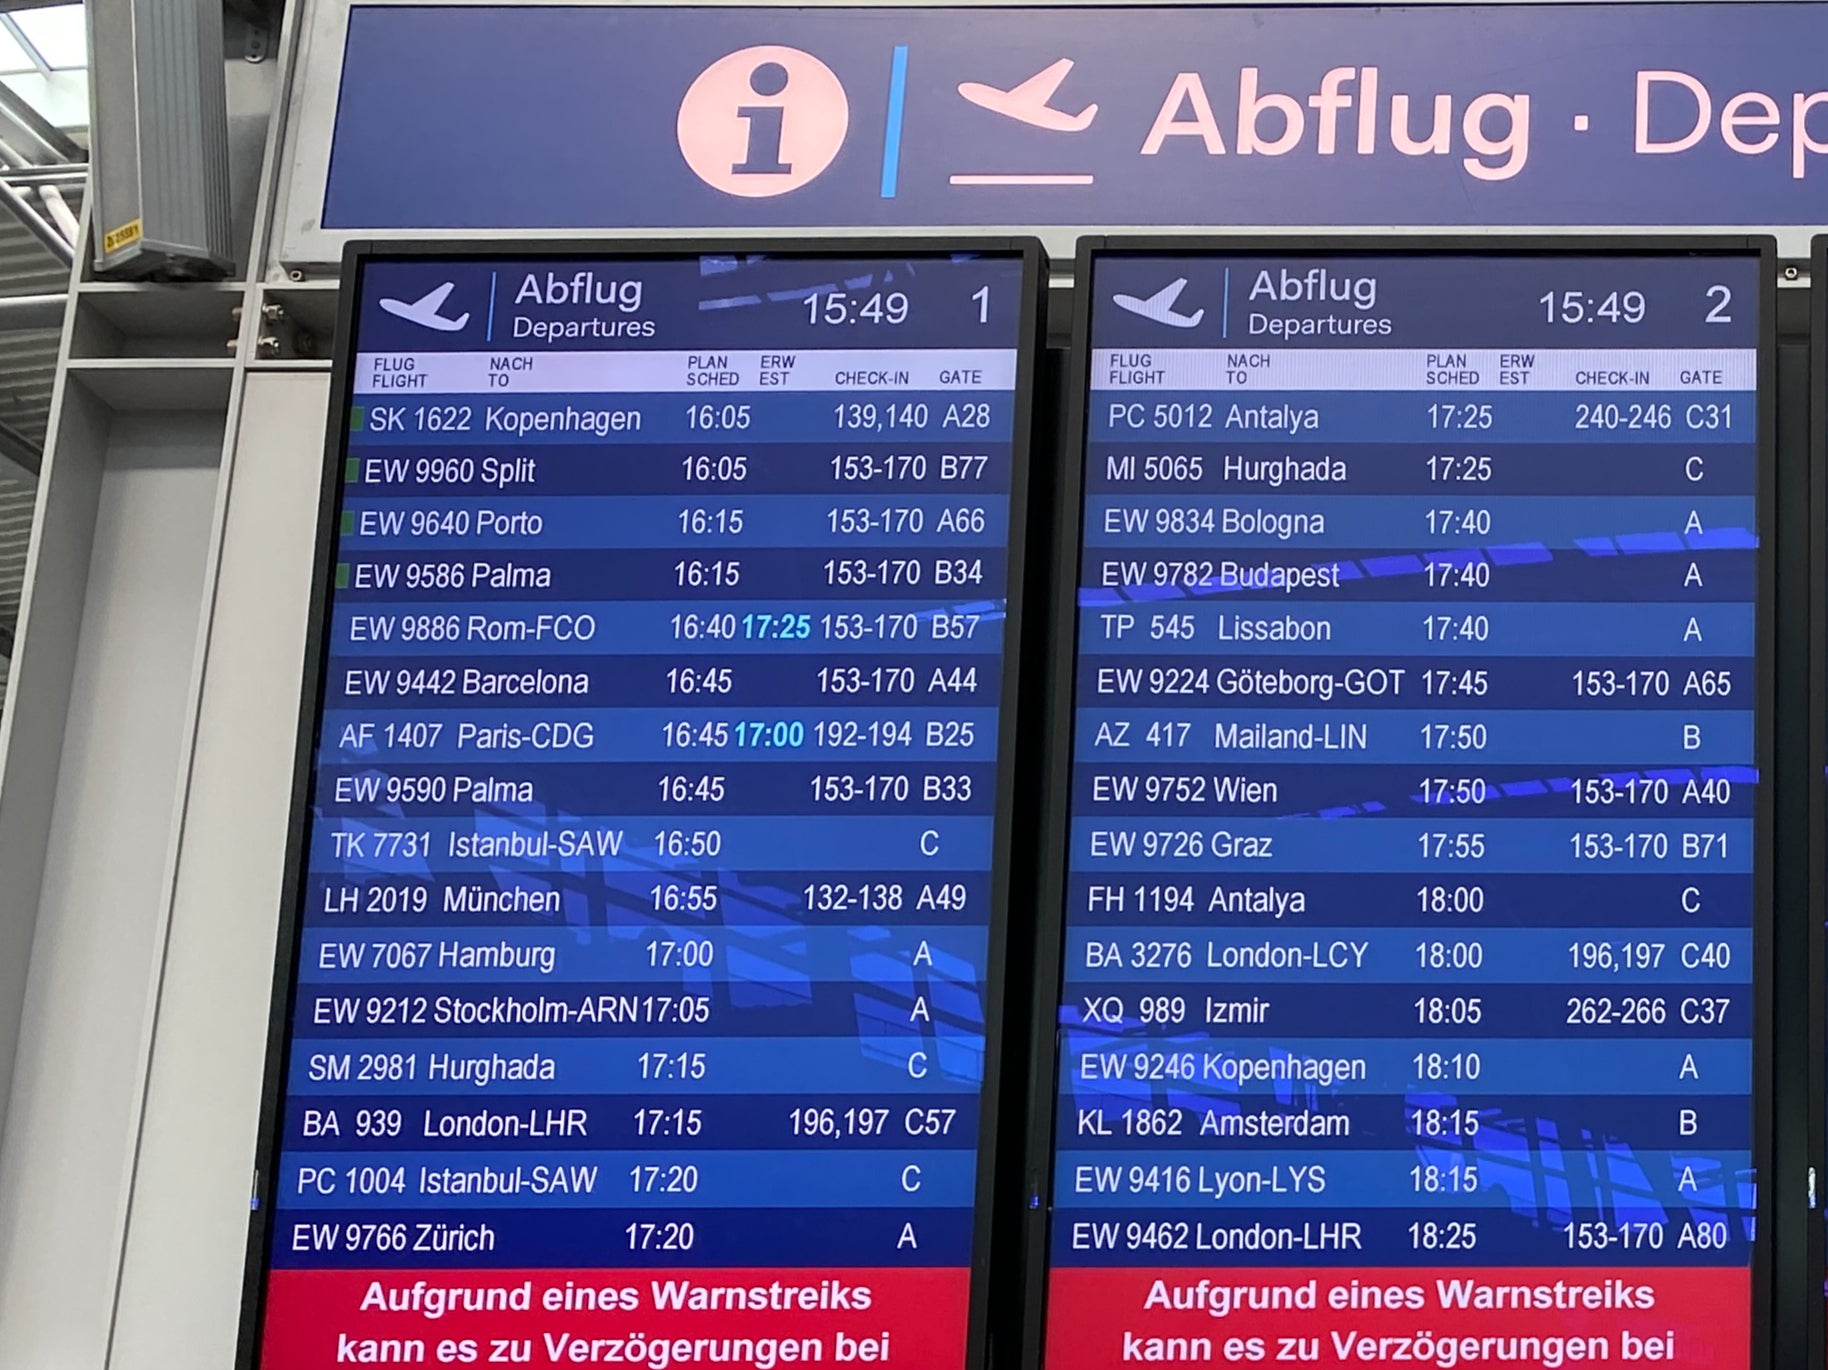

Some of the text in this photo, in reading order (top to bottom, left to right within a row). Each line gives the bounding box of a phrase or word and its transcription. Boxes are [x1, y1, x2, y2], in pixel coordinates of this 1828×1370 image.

[1141, 67, 1529, 180] Abflug
[515, 272, 988, 324] Abflug 15:49 1
[1249, 268, 1731, 323] Abflug 15:49 2
[513, 317, 655, 342] Departures
[1249, 314, 1391, 340] Departures
[372, 369, 981, 388] FLIGHT TO SCHED EST CHECK-IN GATE
[374, 355, 796, 371] FLUG NACH PLAN ERW
[370, 403, 990, 436] SK 1622 Kopenhagen 16:05 139,140 A28
[1107, 455, 1703, 486] MI 5065 Hurghada 17:25 C
[350, 613, 980, 640] EW 9886 Rom-FCO 16:40 17:25 153-170 B57
[1098, 668, 1730, 700] EW 9224 Göteborg-GOT 17:45 153-170 A65
[331, 830, 938, 857] TK 7731 Istanbul-SAW 16:50 C
[1089, 886, 1700, 918] FH 1194 Antalya 18:00 C
[1083, 996, 1729, 1023] XQ 989 Izmir 18:05 262-266 C37
[303, 1108, 956, 1139] BA 939 London-LHR 17:15 196,197 C57
